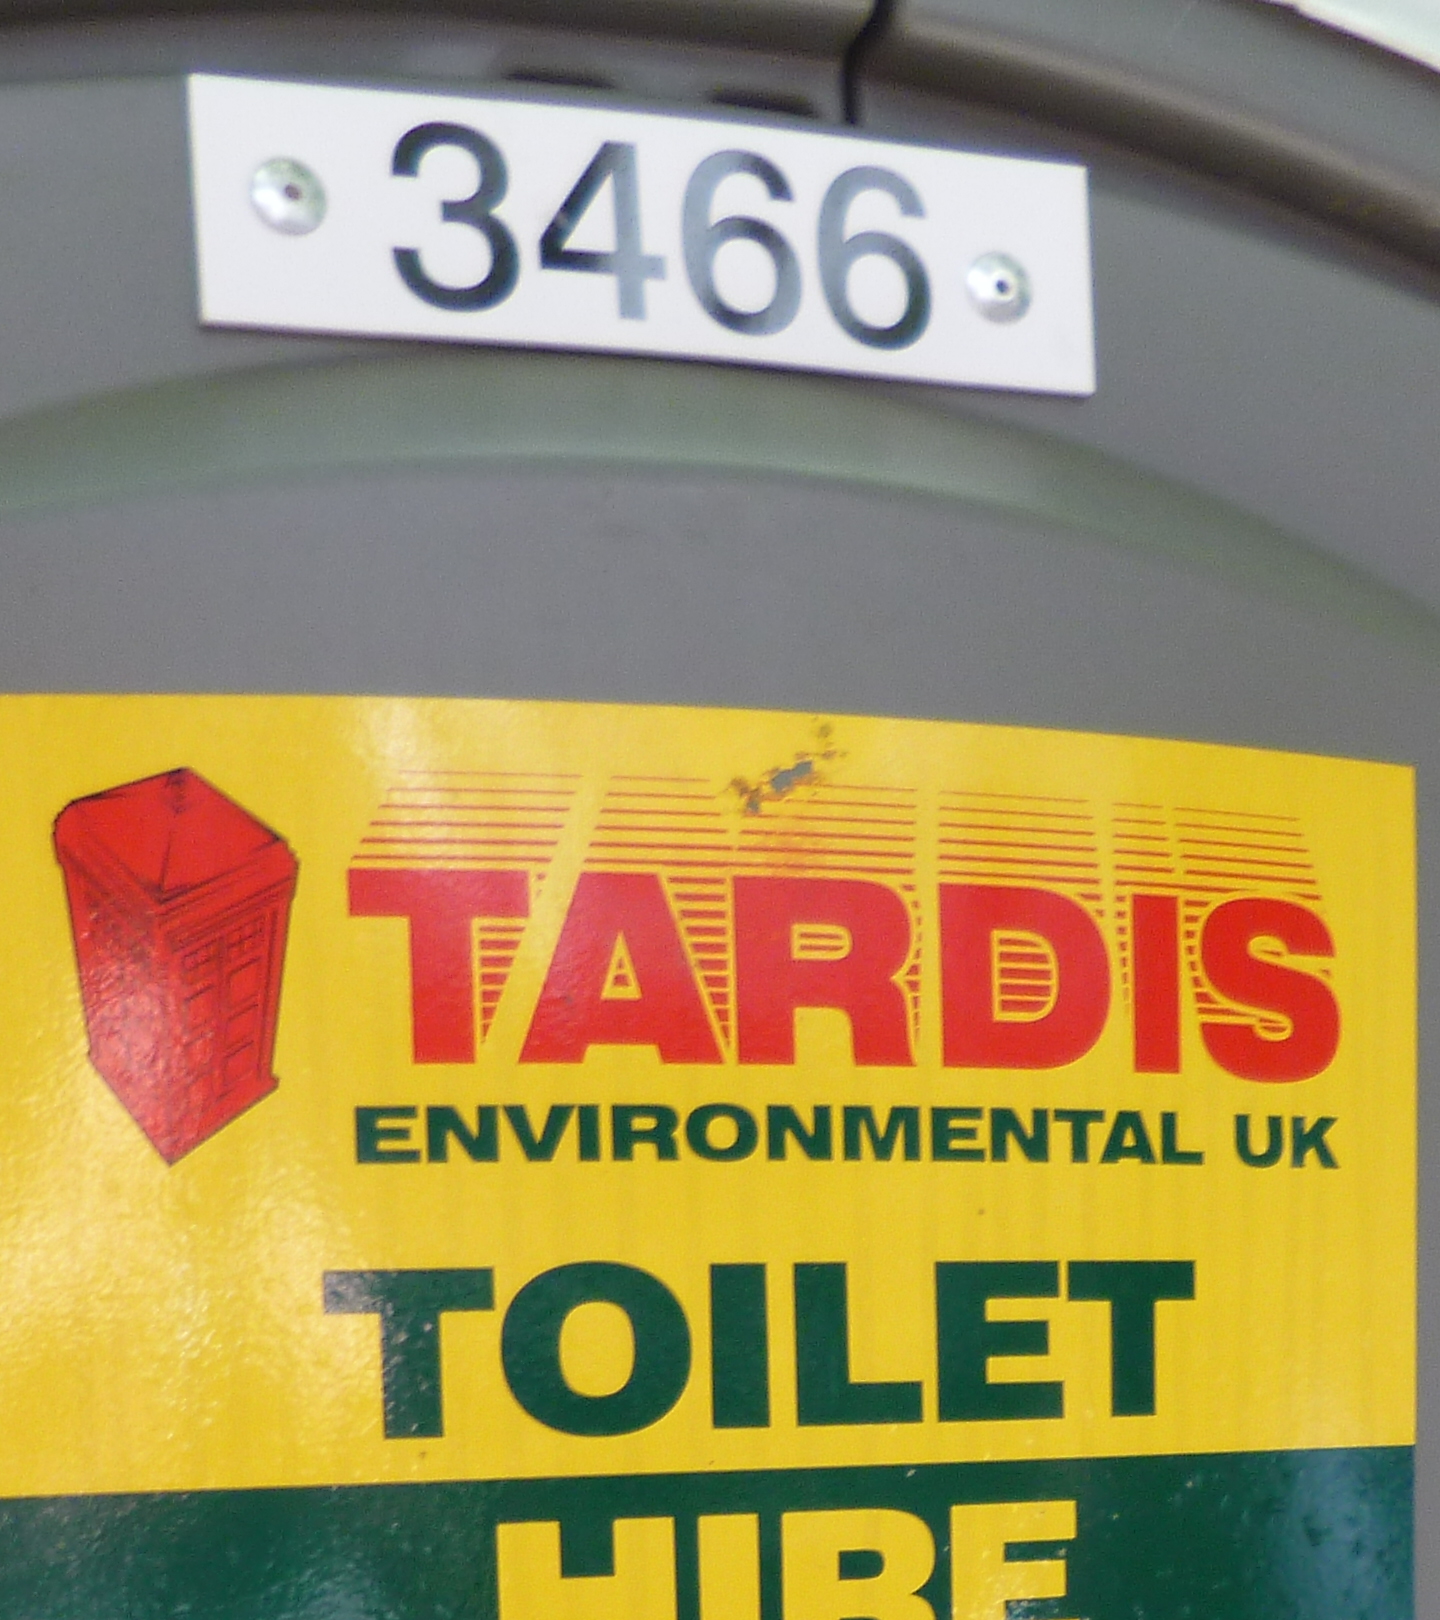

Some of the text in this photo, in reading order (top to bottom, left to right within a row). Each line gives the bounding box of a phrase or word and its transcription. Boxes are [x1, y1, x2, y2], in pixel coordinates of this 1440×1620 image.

[389, 120, 933, 351] 3466
[346, 865, 1342, 1084] TARDIS
[356, 1102, 1339, 1170] ENVIRONMENTAL UK
[322, 1259, 1196, 1441] TOILET
